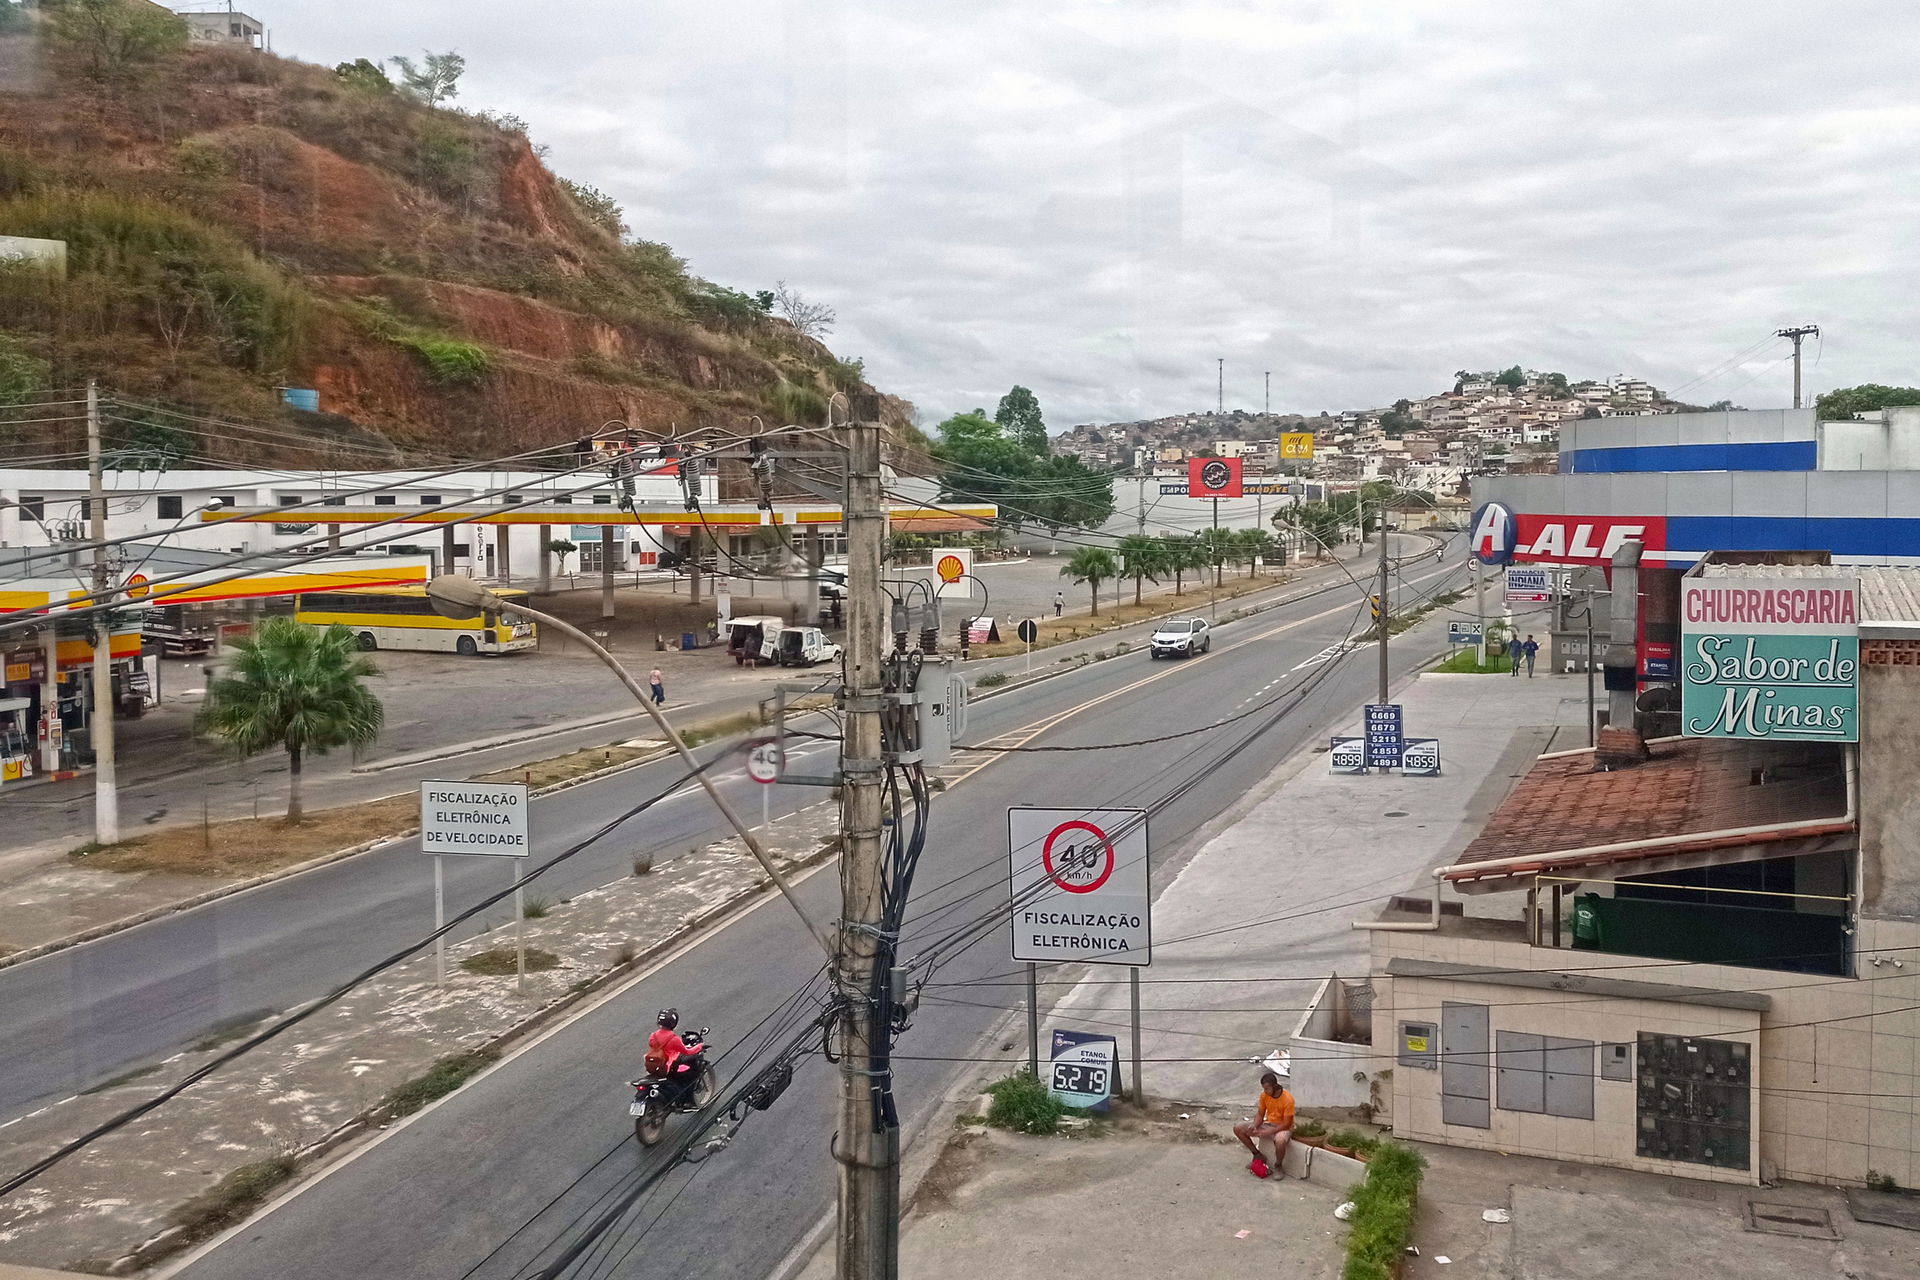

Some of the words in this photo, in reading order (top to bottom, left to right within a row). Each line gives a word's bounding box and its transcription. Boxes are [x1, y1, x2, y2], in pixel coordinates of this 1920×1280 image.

[1161, 486, 1189, 494] EMPO
[1508, 576, 1545, 587] INDIANA
[1686, 588, 1856, 624] CHURRASCARIA
[1686, 635, 1809, 684] Sabor
[1814, 638, 1855, 682] de
[1371, 712, 1396, 720] 6669
[1688, 687, 1852, 736] Minas
[1371, 724, 1396, 732] 6679
[1372, 735, 1397, 743] 5219
[1372, 747, 1398, 755] 4859
[429, 792, 518, 807] FISCALIZAÇÃO
[436, 810, 511, 825] ELETRÔNICA
[427, 832, 443, 842] DE
[446, 832, 524, 845] VELOCIDADE
[1060, 845, 1098, 869] 40
[1066, 871, 1093, 880] km/h
[1024, 912, 1141, 930] FISCALIZAÇÃO
[1033, 933, 1130, 951] ELETRÔNICA
[1080, 1050, 1108, 1059] ETANOL
[1080, 1057, 1107, 1066] COMUM
